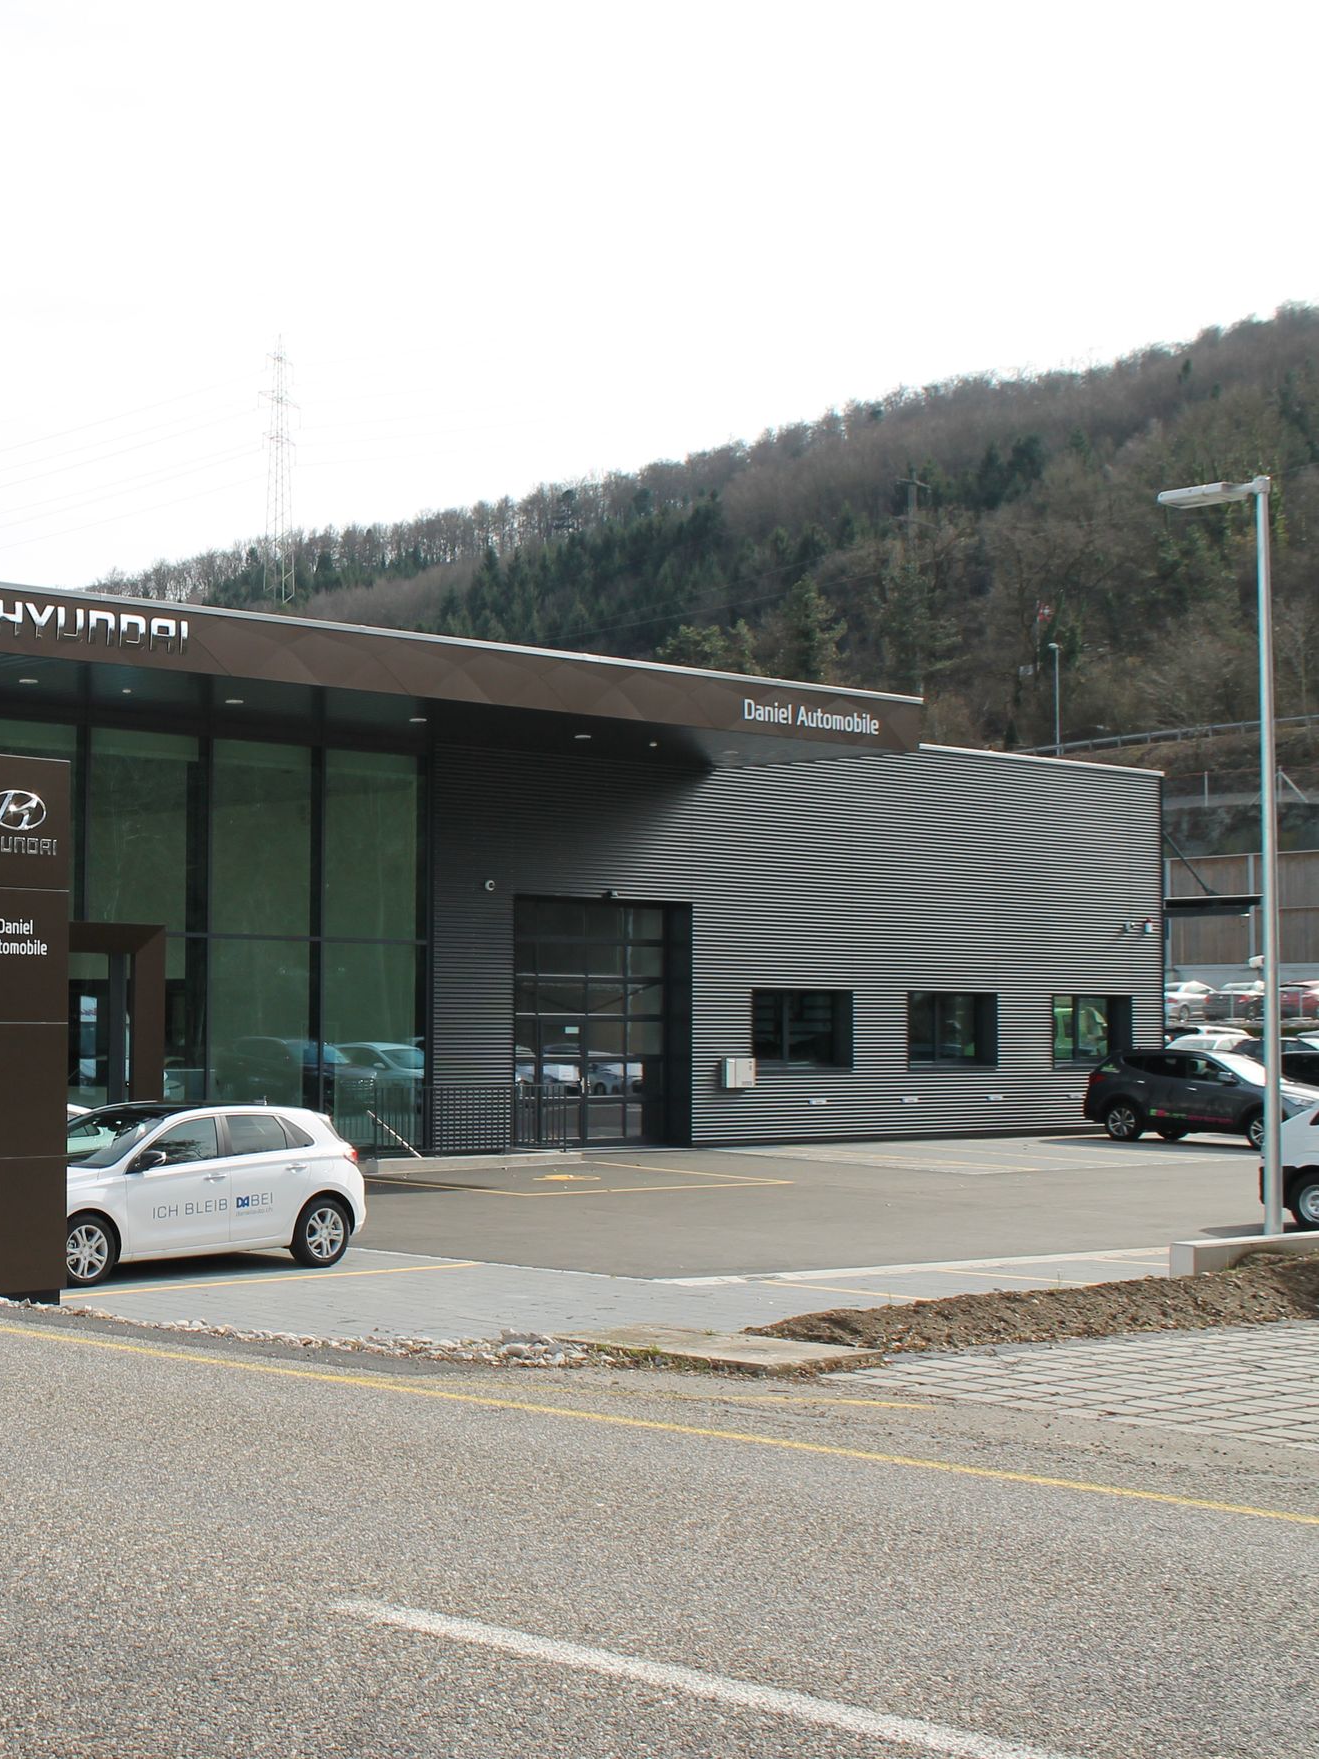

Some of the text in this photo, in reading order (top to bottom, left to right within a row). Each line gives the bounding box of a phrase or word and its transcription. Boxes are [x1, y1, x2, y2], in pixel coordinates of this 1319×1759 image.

[744, 699, 879, 735] Daniel Automobile
[152, 1192, 273, 1219] ICH BLEIB DABEI
